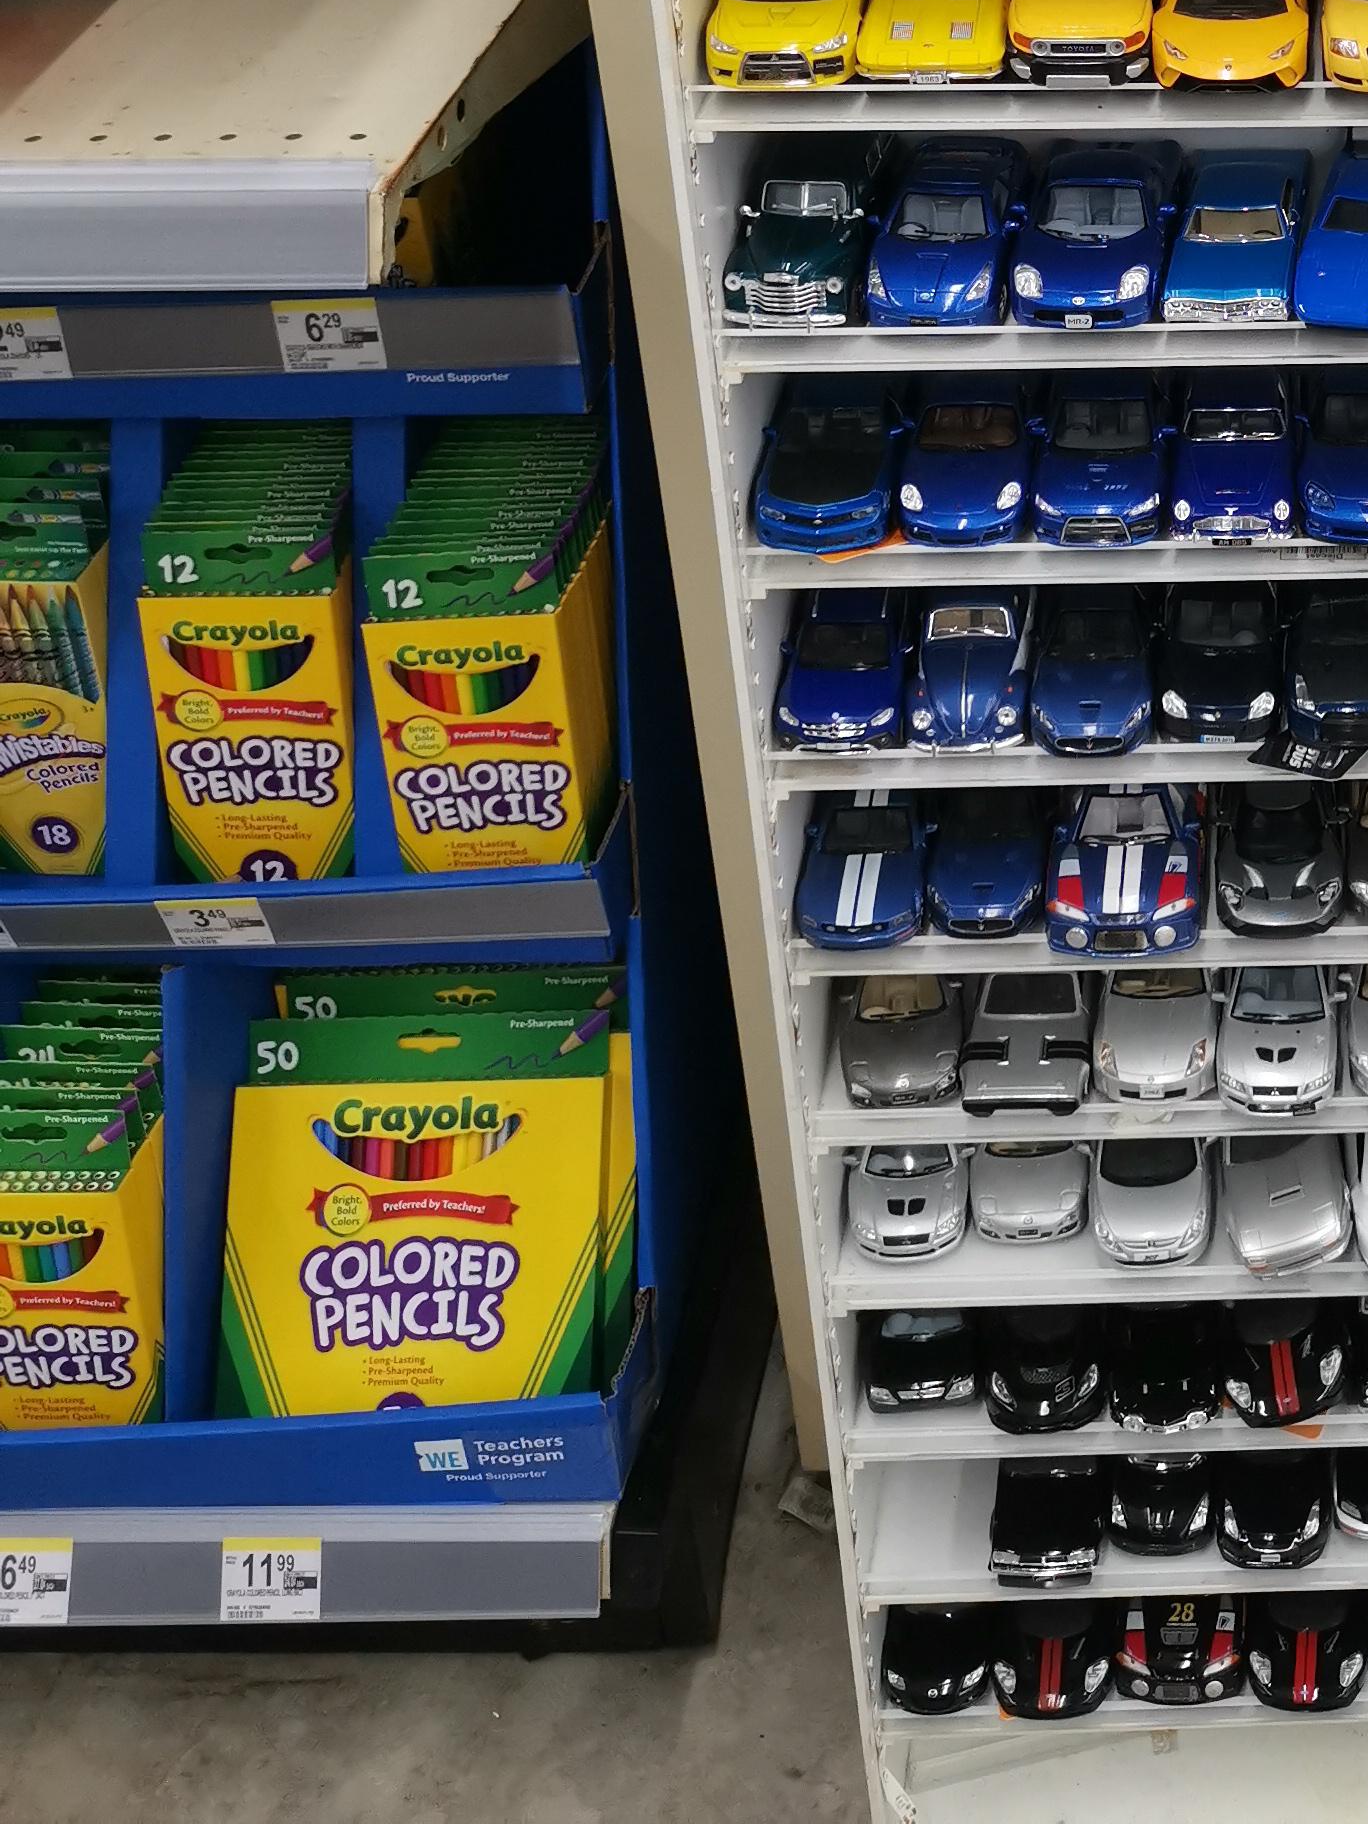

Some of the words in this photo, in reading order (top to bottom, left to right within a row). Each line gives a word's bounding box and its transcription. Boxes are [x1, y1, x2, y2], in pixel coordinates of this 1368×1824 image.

[1062, 45, 1095, 53] TOYOTA
[406, 372, 444, 382] Proud
[447, 372, 511, 383] Supporter
[248, 534, 314, 544] Pre-Sharpened
[471, 552, 537, 564] Pre-Sharpened
[158, 554, 199, 584] 12
[382, 578, 424, 609] 12
[172, 620, 300, 646] Crayola
[396, 640, 525, 669] Crayola
[227, 707, 269, 716] Preferred
[271, 707, 281, 716] by
[283, 707, 324, 719] Teachers!
[453, 731, 495, 741] Preferred
[497, 730, 508, 740] by
[170, 739, 340, 771] COLORED
[27, 762, 100, 782] Colored
[40, 771, 98, 793] Pencils
[184, 769, 334, 804] PENCILS
[397, 762, 568, 800] COLORED
[411, 793, 563, 831] PENCILS
[221, 814, 288, 823] Long-Lasting
[223, 823, 298, 832] Pre-Sharpened
[37, 824, 71, 846] 18
[225, 832, 270, 840] Premium
[273, 832, 312, 841] Quality
[451, 840, 517, 850] Long-Lasting
[251, 860, 288, 882] 12
[544, 976, 609, 986] Pre-Sharpened
[294, 996, 338, 1021] 50
[510, 1017, 575, 1029] Pre-Sharpened
[100, 1033, 160, 1042] Pre-Sharpened
[256, 1041, 300, 1074] 50
[76, 1066, 138, 1075] Pre-Sharpened
[58, 1092, 121, 1101] Pre-Sharpened
[44, 1116, 108, 1124] Pre-Sharpened
[333, 1095, 500, 1140] Crayola
[337, 1206, 357, 1215] Bold
[383, 1199, 427, 1212] Preferred
[428, 1199, 440, 1210] by
[443, 1200, 486, 1214] Teachers!
[331, 1217, 360, 1226] Colors
[304, 1241, 515, 1296] COLORED
[20, 1296, 60, 1305] Preferred
[62, 1296, 73, 1305] by
[75, 1297, 116, 1308] Teachers!
[315, 1289, 499, 1347] PENCILS
[369, 1356, 426, 1366] Long-Lasting
[0, 1354, 131, 1386] ENCILS
[368, 1366, 433, 1376] Pre-Sharpened
[368, 1377, 408, 1386] Premium
[410, 1376, 444, 1387] Quality
[425, 1451, 463, 1469] WE
[473, 1436, 564, 1452] Teachers
[478, 1450, 564, 1466] Program
[446, 1473, 483, 1482] Proud
[485, 1470, 547, 1481] Supporter
[1168, 1603, 1196, 1622] 28
